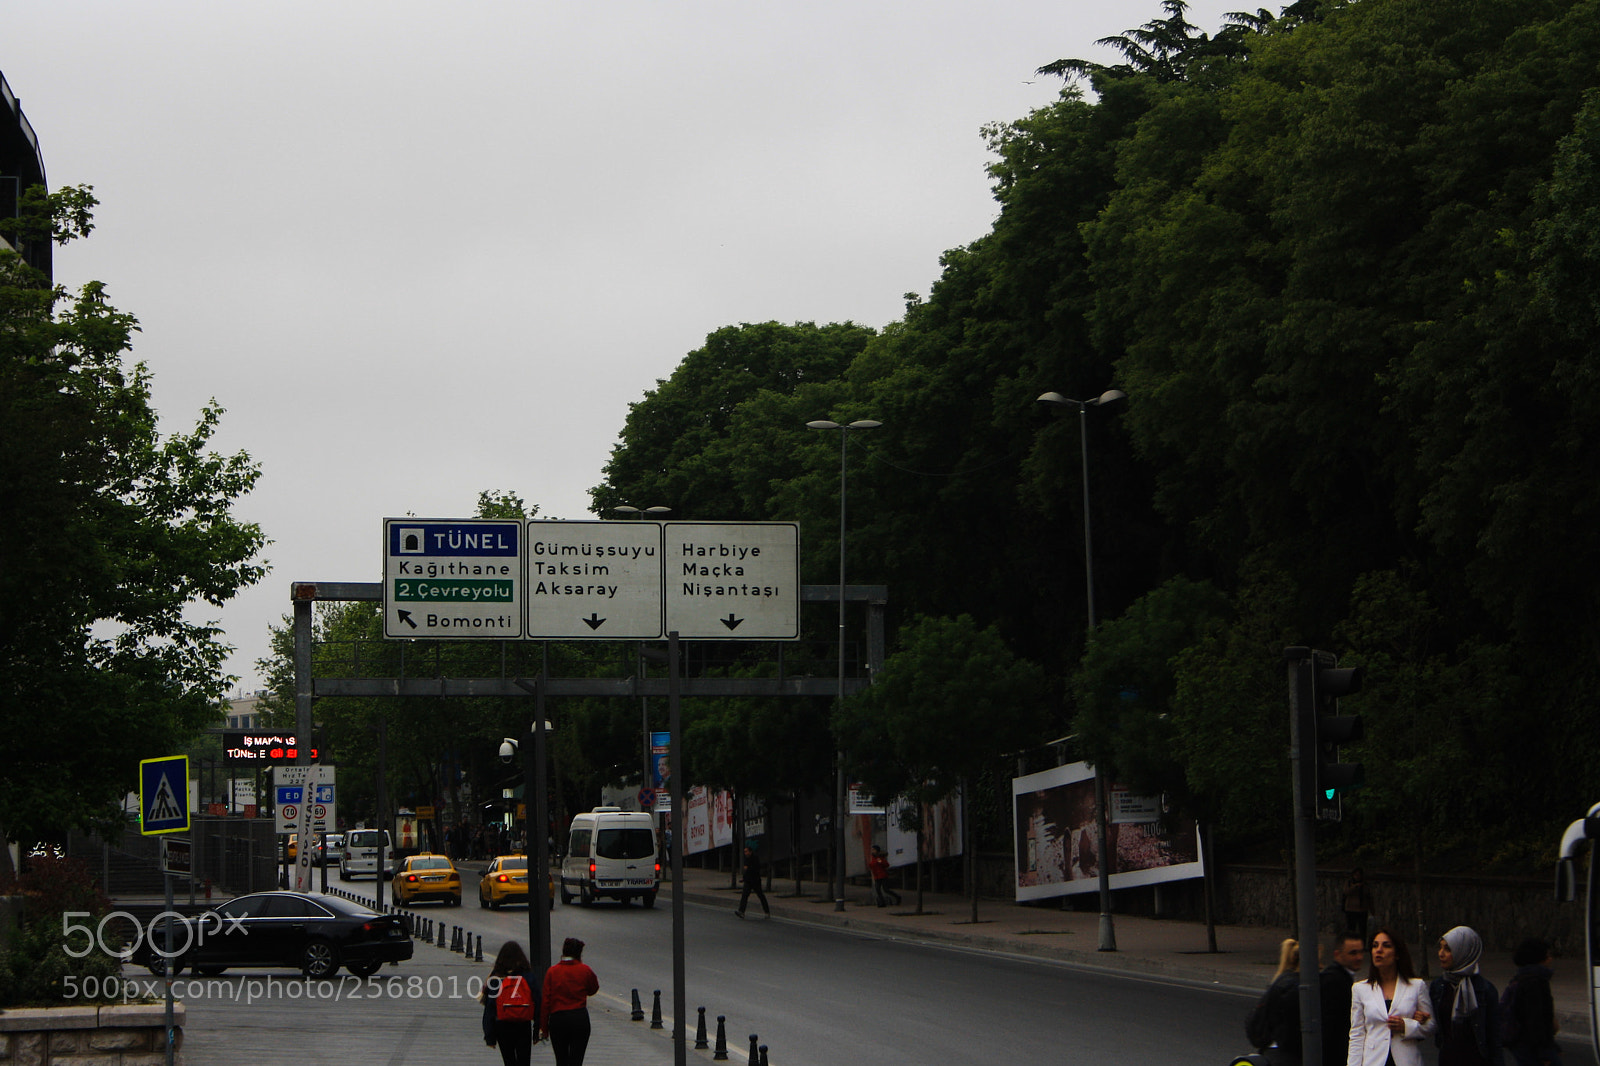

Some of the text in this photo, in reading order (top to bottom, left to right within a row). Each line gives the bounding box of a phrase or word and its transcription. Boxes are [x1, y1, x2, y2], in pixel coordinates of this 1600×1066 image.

[434, 530, 509, 549] TÜNEL
[534, 542, 655, 560] Gümüşsuyu
[682, 543, 761, 560] Harbiye
[399, 561, 510, 578] Kağıthane
[535, 562, 609, 576] Taksim
[683, 563, 744, 578] Maçka
[535, 581, 618, 599] Aksaray
[683, 582, 778, 598] Nişantaşı
[427, 614, 511, 628] Bomonti
[285, 792, 300, 800] ED
[285, 808, 296, 816] 70
[314, 808, 324, 816] 60
